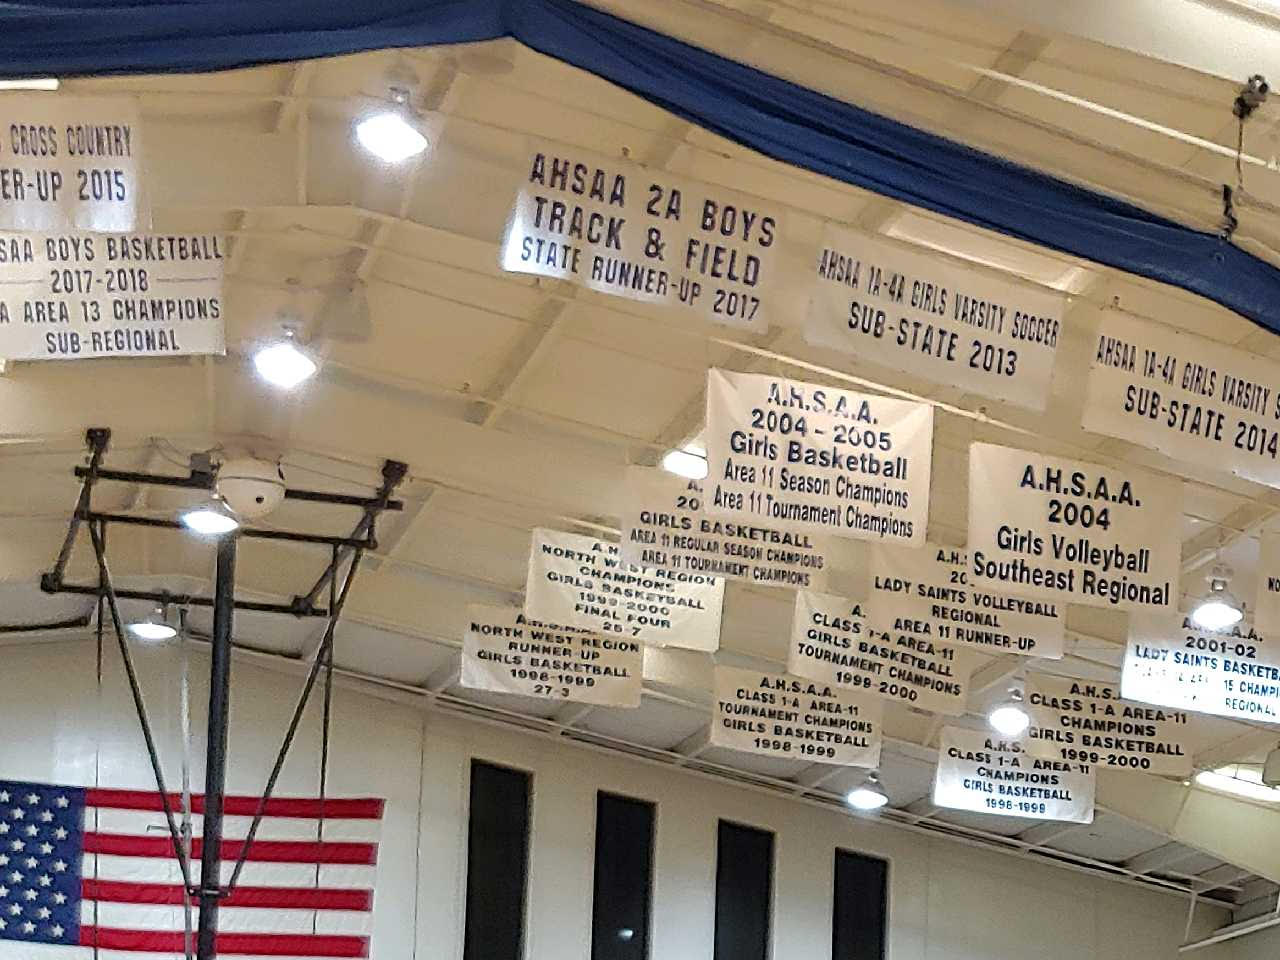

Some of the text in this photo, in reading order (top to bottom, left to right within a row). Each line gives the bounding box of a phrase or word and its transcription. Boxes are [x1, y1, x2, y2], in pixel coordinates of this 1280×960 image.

[10, 124, 131, 157] CROSS COUNTRY
[77, 168, 126, 201] 2015
[529, 153, 776, 247] AHSAA 2A BOYS
[46, 236, 95, 261] BOYS
[107, 235, 223, 261] BASKETBALL
[534, 196, 760, 288] TRACK & FIELD
[51, 268, 149, 294] 2017-2018
[521, 235, 760, 321] STATE RUNNER-UP 2017
[24, 298, 220, 323] AREA 13 CHAMPIONS
[819, 249, 1059, 348] AHSAA 1A-4A GIRLS VARSITY SOCCER
[46, 328, 180, 354] SUB-REGIONAL
[848, 302, 1017, 377] SUB-STATE 2013
[1097, 336, 1136, 373] AHSAA
[1144, 350, 1177, 385] 1A-4A
[1182, 362, 1217, 398] GIRLS
[1222, 375, 1270, 416] VARSITY
[768, 383, 878, 424] A.H.S.A.A.
[752, 409, 893, 451] 2004 2005
[1124, 385, 1278, 459] SUB-STATE 2014
[730, 430, 907, 479] Girls Basketball
[724, 457, 909, 510] Area 11 Season Champions
[1020, 464, 1141, 507] A.H.S.A.A.
[714, 485, 743, 510] Area
[750, 489, 762, 514] 11
[766, 494, 841, 528] Tournament
[846, 505, 913, 538] Champions
[1048, 499, 1111, 530] 2004
[640, 511, 813, 549] GIRLS BASKETBALL
[542, 544, 596, 565] NORTH
[630, 528, 657, 544] AREA
[673, 536, 720, 554] REGULAR
[724, 542, 763, 560] SEASON
[766, 549, 824, 570] CHAMPIONS
[997, 525, 1149, 574] Girls Volleyball
[579, 566, 676, 593] CHAMPIONS
[642, 549, 667, 566] AREA
[685, 556, 750, 577] TOURNAMENT
[753, 566, 810, 587] CHAMPIONS
[974, 551, 1169, 606] Southeast Regional
[546, 571, 705, 610] GIRLS BASKETBALL
[875, 576, 1058, 618] LADY SAINTS VOLLEYBALL
[575, 603, 672, 629] FINAL FOUR
[812, 613, 861, 634] CLASS
[932, 605, 1001, 627] REGIONAL
[471, 622, 523, 638] NORTH
[531, 631, 574, 645] WEST
[581, 638, 640, 653] REGION
[894, 618, 931, 635] AREA
[956, 628, 1036, 651] RUNNER-UP
[1185, 636, 1257, 659] 2001-02
[477, 650, 630, 678] GIRLS BASKETBALL
[798, 642, 961, 696] TOURNAMENT CHAMPIONS
[807, 629, 953, 677] GIRLS BASKETBALL
[1136, 645, 1168, 660] LADY
[1174, 652, 1218, 669] SAINTS
[736, 688, 776, 705] CLASS
[810, 701, 859, 716] AREA-11
[760, 677, 837, 698] A.H.S.A.A.
[718, 701, 873, 733] TOURNAMENT CHAMPIONS
[1030, 693, 1186, 724] CLASS 1-A AREA-11
[723, 718, 869, 748] GIRLS BASKETBALL
[1029, 727, 1184, 756] GIRLS BASKETBALL
[1060, 715, 1156, 737] CHAMPIONS
[948, 747, 991, 764] CLASS
[1033, 759, 1089, 774] AREA-11
[1060, 748, 1150, 769] 1999-2000
[964, 778, 1072, 801] GIRLS BASKETBALL
[977, 766, 1059, 785] CHAMPIONS
